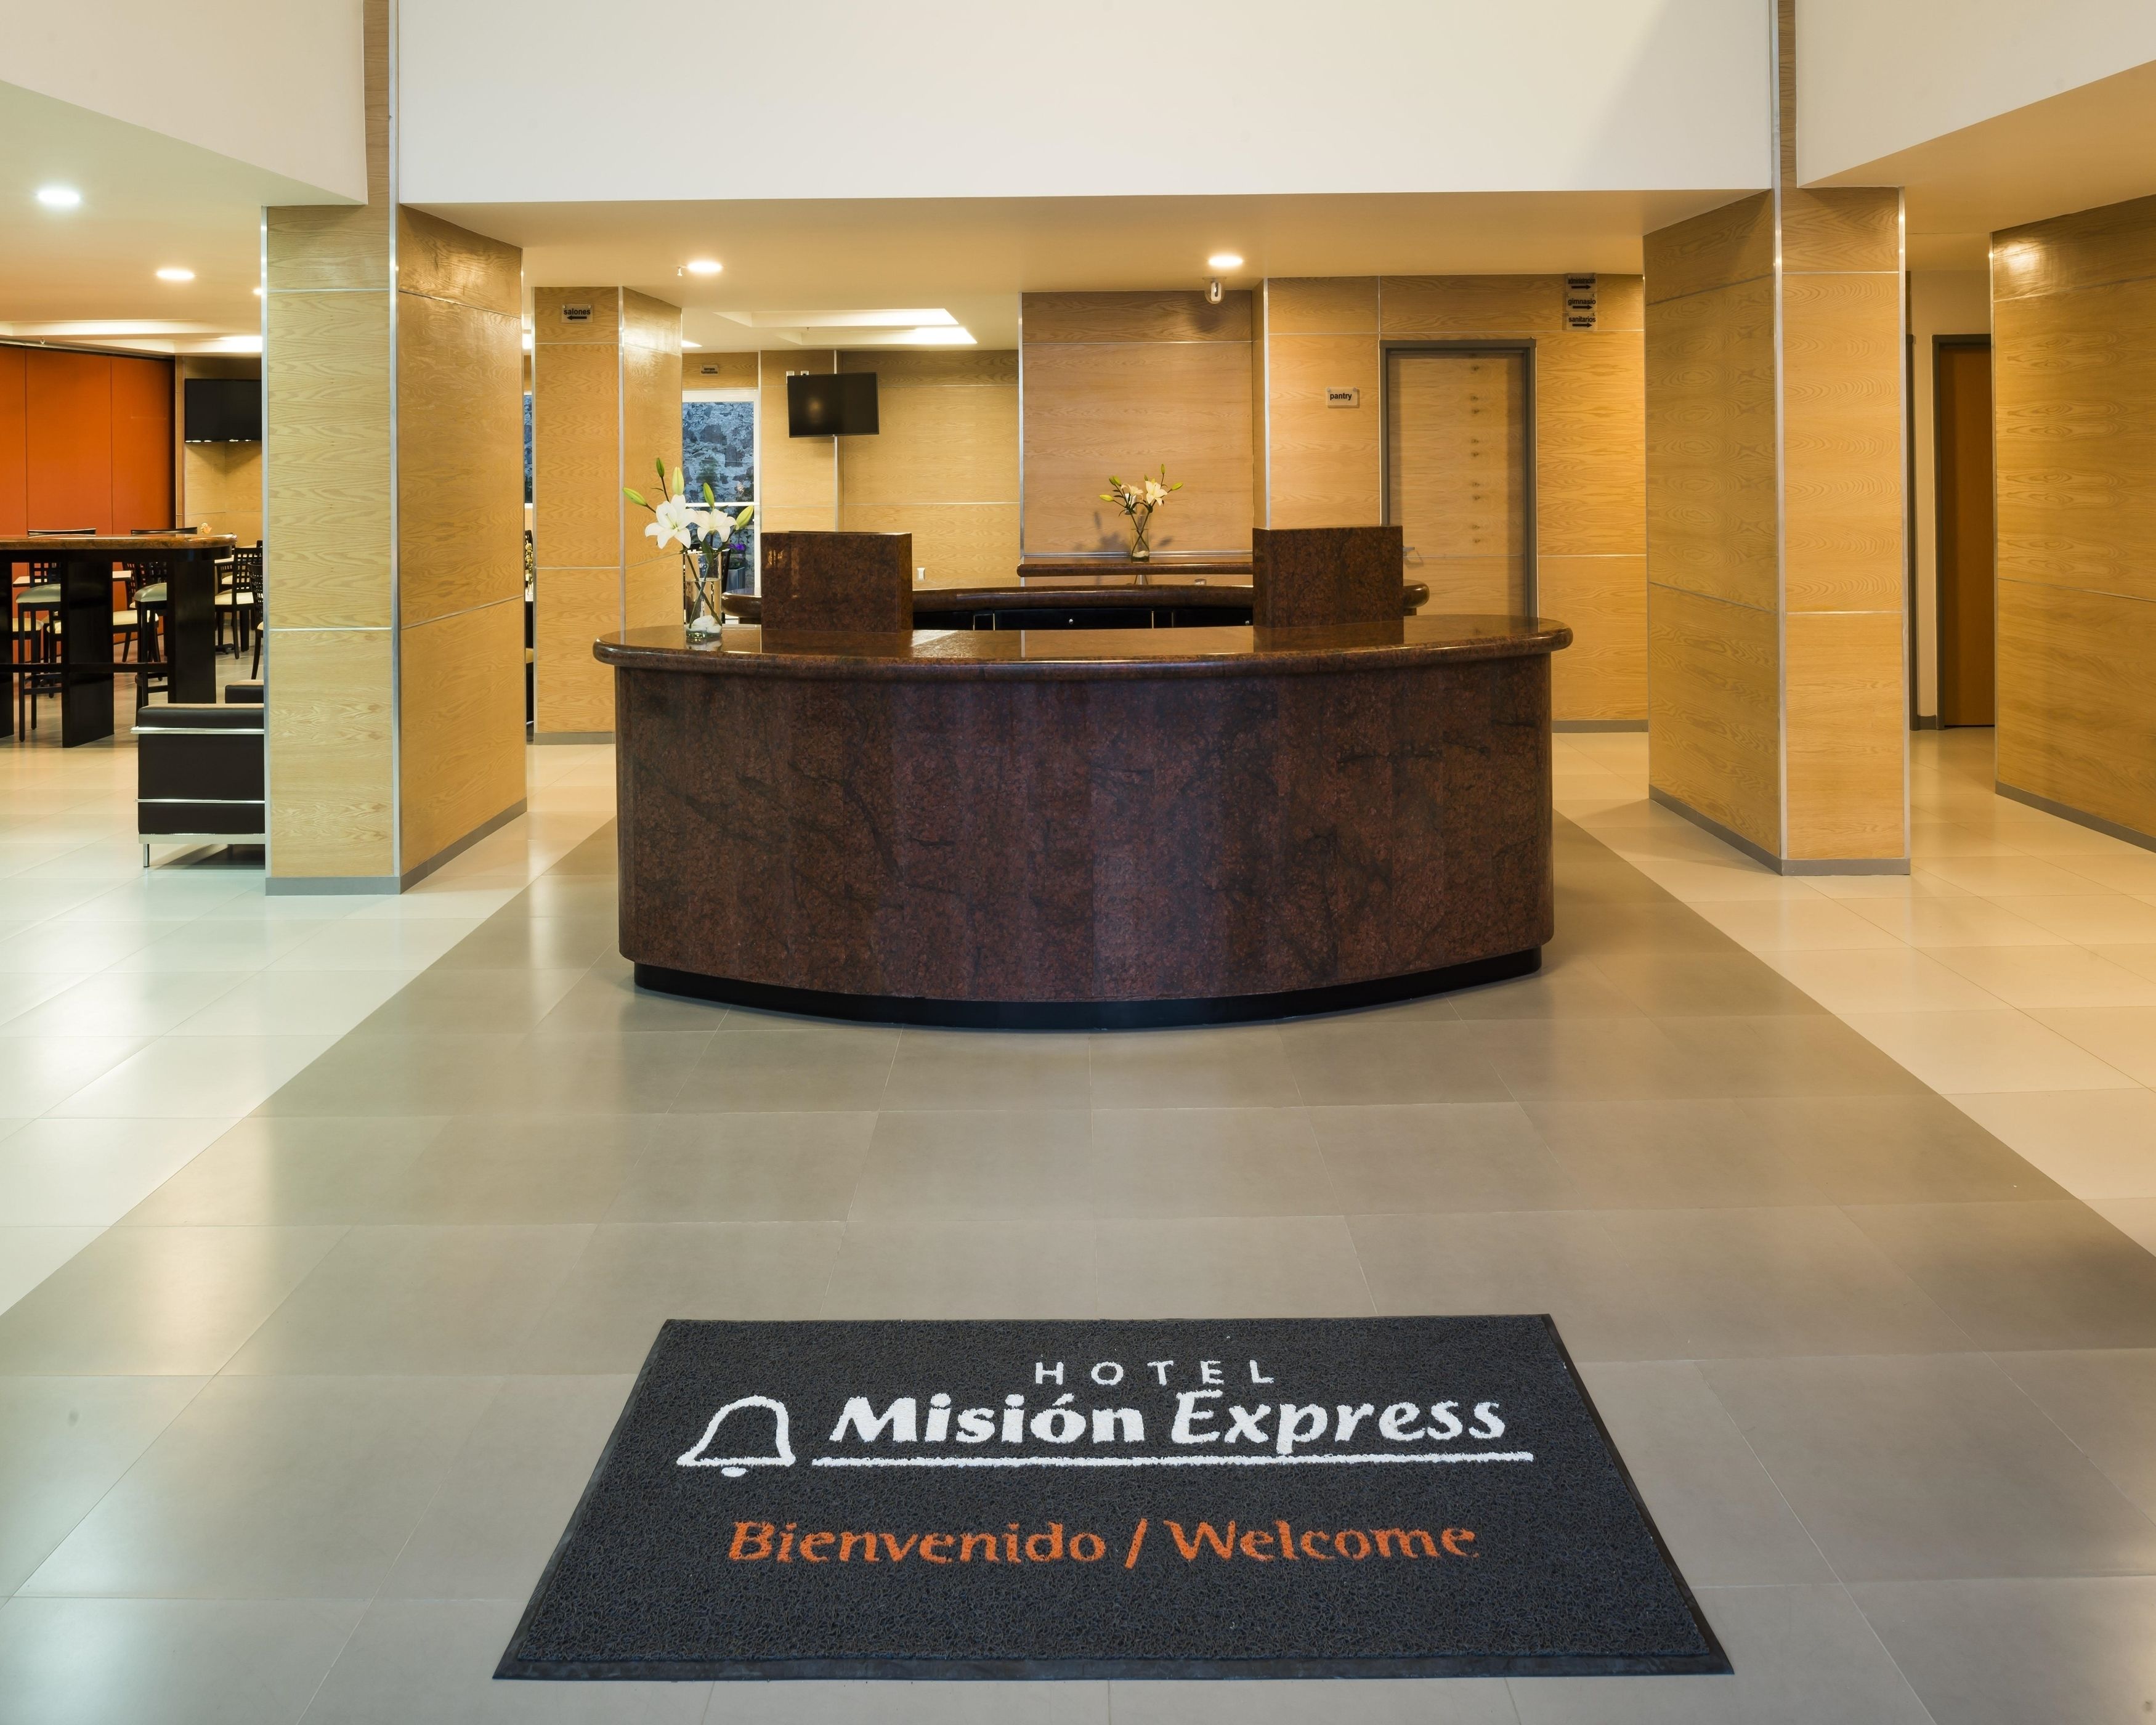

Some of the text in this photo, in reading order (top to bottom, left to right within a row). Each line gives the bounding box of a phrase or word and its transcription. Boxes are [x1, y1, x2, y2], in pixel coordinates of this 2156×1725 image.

[1568, 298, 1596, 306] gimnasio
[1330, 392, 1352, 400] pantry
[1035, 1359, 1273, 1386] HOTEL
[829, 1389, 1507, 1455] Misión Express
[729, 1520, 1106, 1564] Bienvenido
[1165, 1519, 1476, 1561] Welcome
